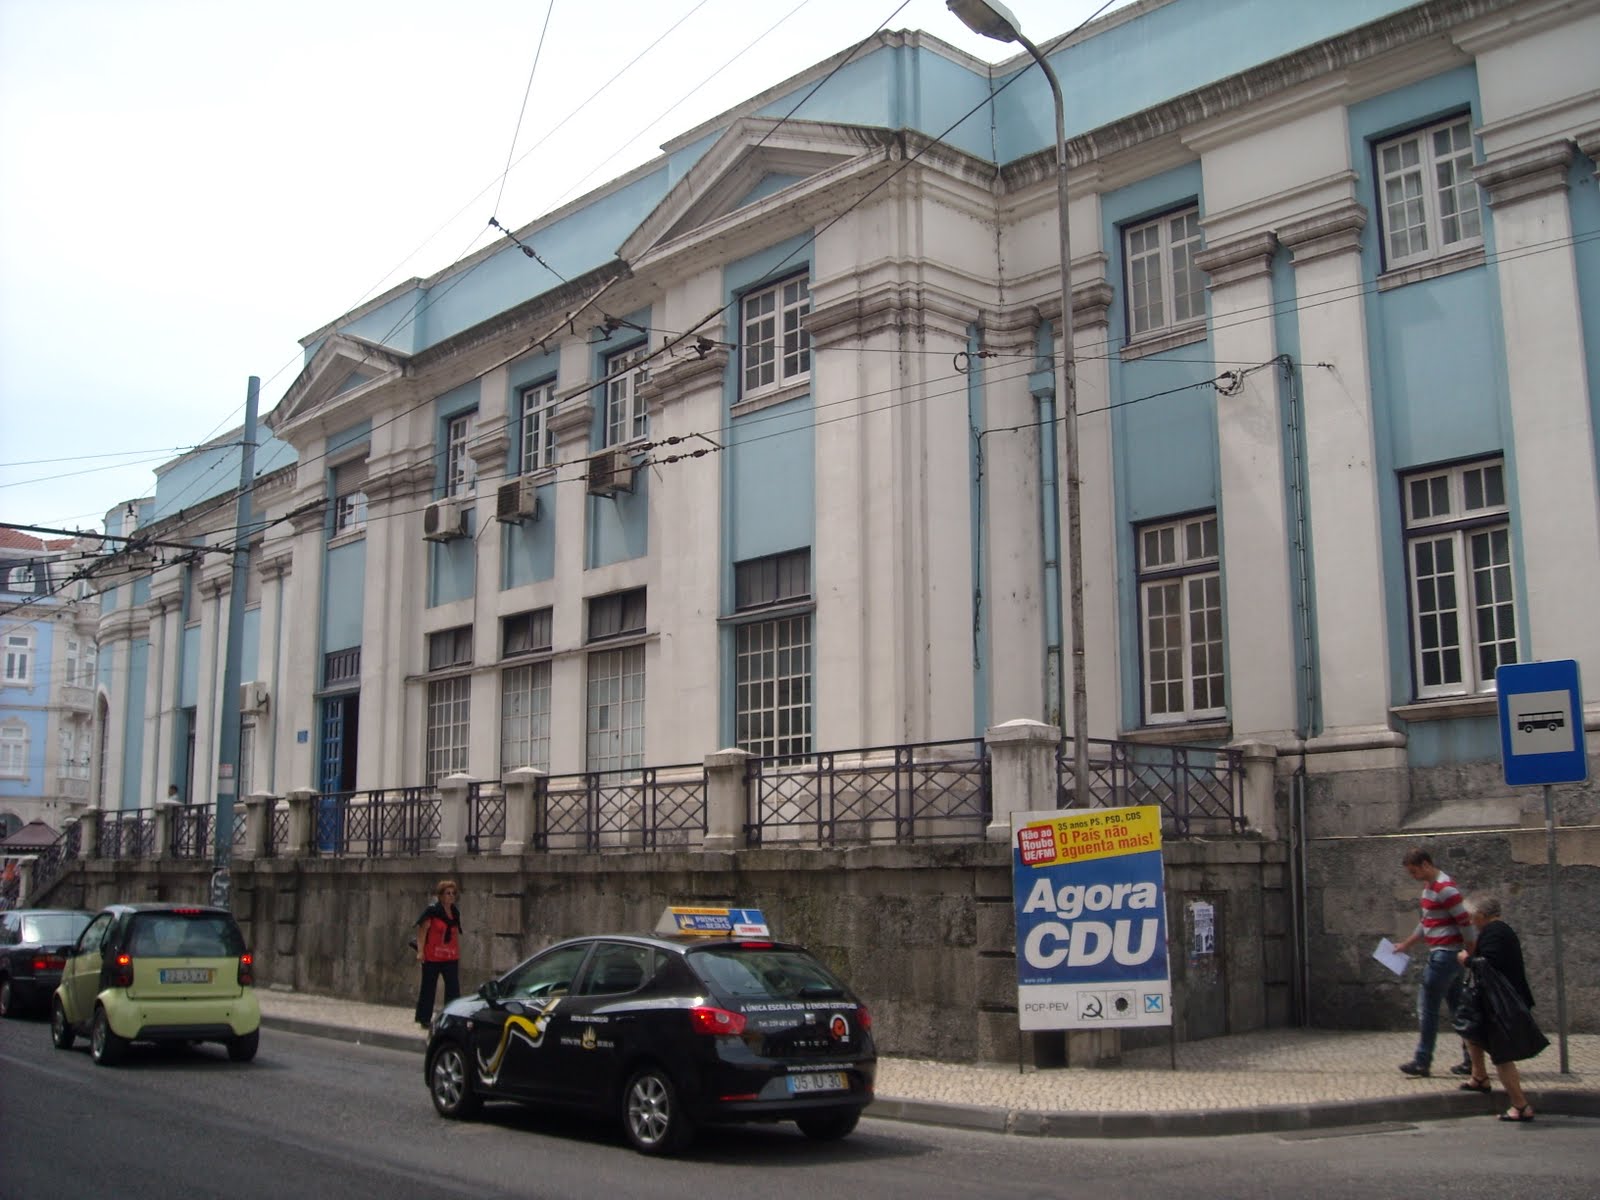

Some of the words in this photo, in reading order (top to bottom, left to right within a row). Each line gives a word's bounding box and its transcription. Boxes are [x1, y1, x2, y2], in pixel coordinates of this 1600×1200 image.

[1058, 823, 1068, 831] 35
[1070, 821, 1088, 830] anos
[1090, 818, 1103, 827] PS,
[1106, 815, 1124, 824] PSD,
[1126, 812, 1142, 822] CDS
[1021, 829, 1039, 841] Não
[1040, 829, 1053, 838] ao
[1059, 832, 1068, 845] O
[1072, 828, 1101, 843] País
[1105, 825, 1128, 839] não
[1023, 838, 1054, 851] Roubo
[1061, 840, 1115, 859] aguenta
[1119, 832, 1154, 849] mais!
[1023, 848, 1056, 861] UE/FMI
[1022, 878, 1158, 920] Agora
[741, 910, 752, 924] L
[1024, 919, 1159, 969] CDU
[746, 1003, 767, 1012] ÚNICA
[767, 1003, 791, 1011] ESCOLA
[1024, 1003, 1069, 1012] PCP-PEV
